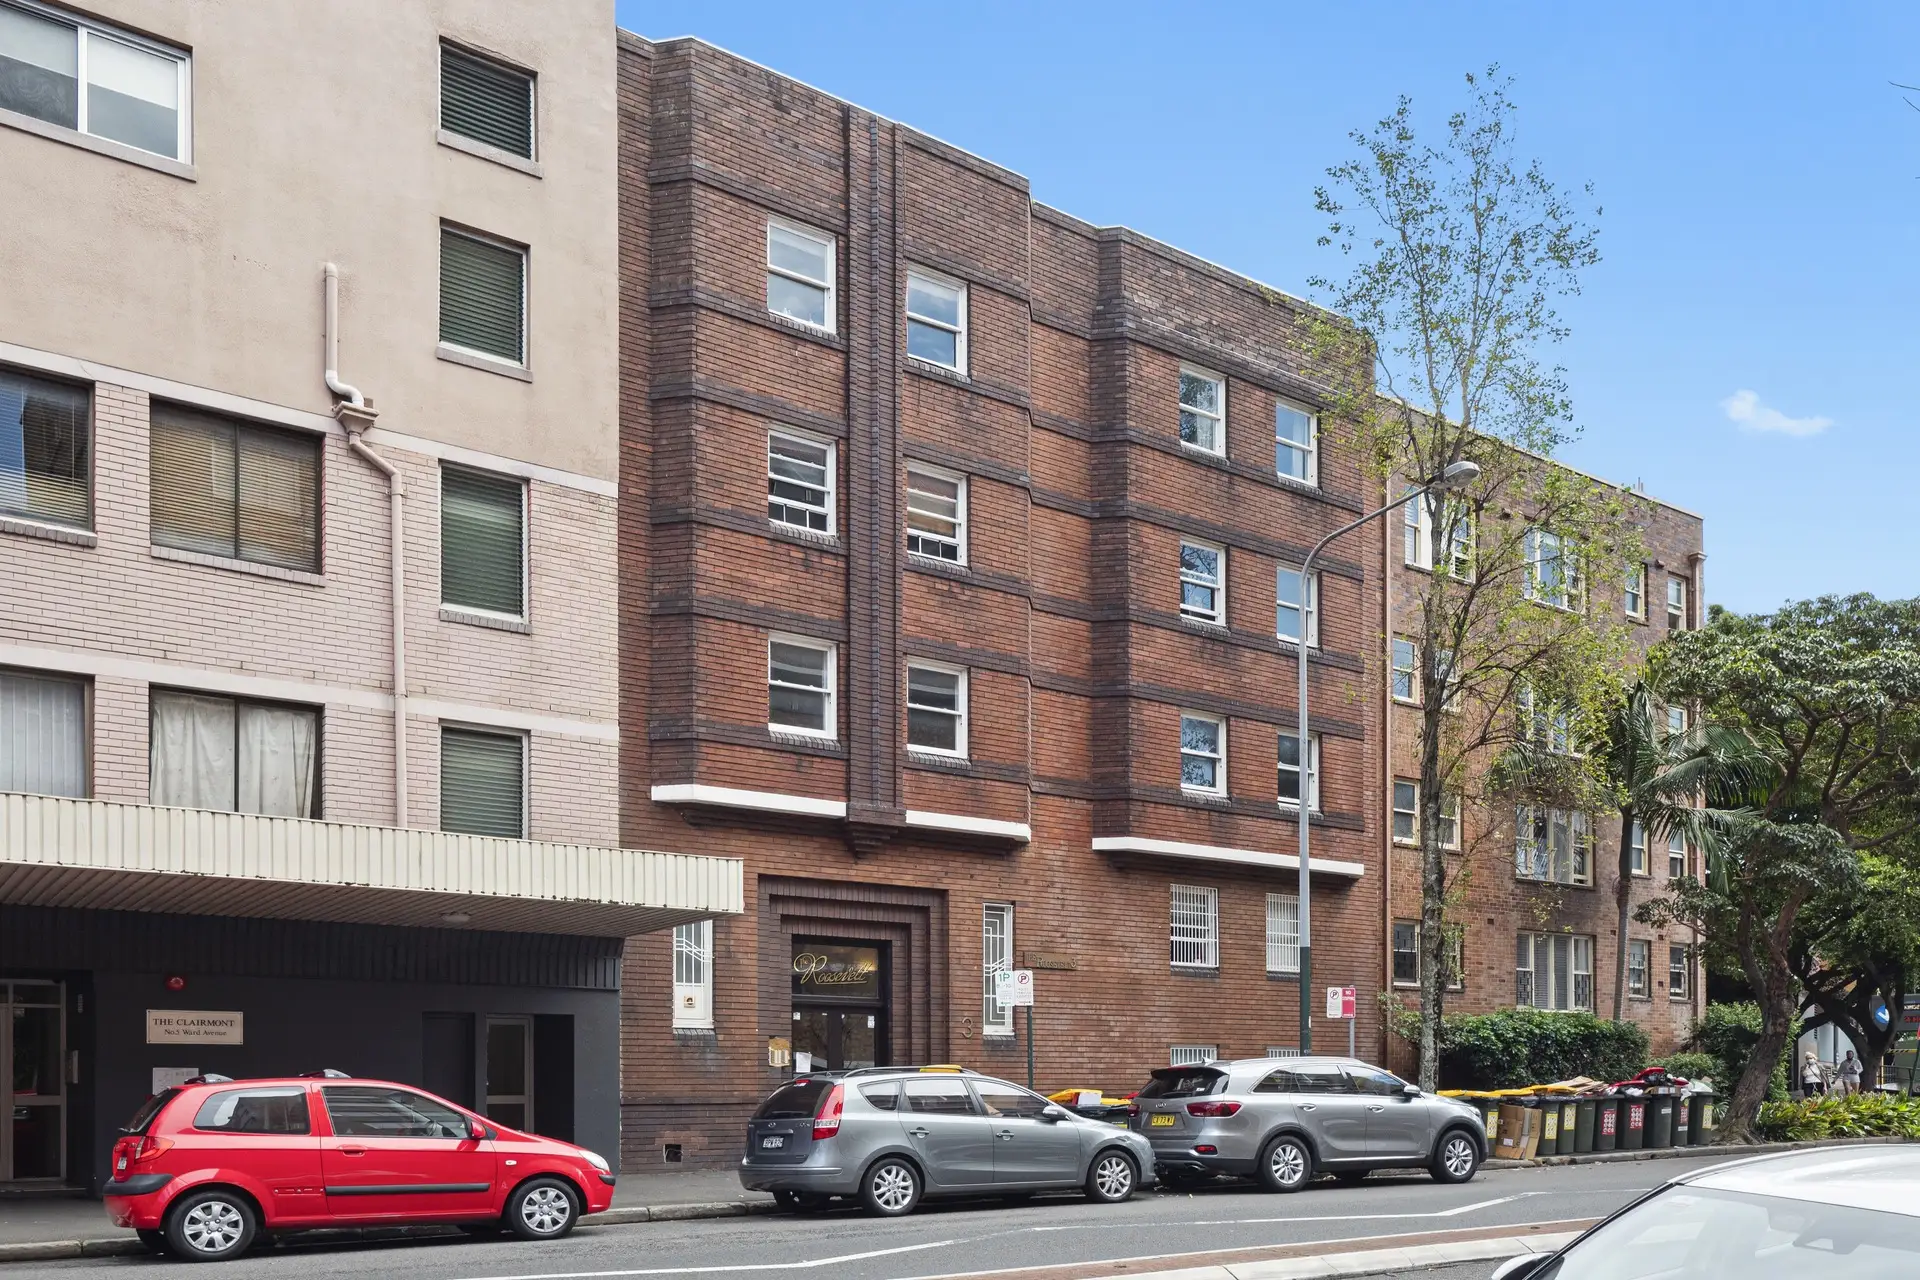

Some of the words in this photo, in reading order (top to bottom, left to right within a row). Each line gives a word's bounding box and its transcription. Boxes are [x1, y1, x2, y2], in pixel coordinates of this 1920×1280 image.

[793, 952, 873, 985] Roosevelt
[999, 972, 1010, 982] 1P
[153, 1018, 174, 1026] THE
[176, 1018, 235, 1027] CLAIRMONT
[961, 1016, 973, 1039] 3
